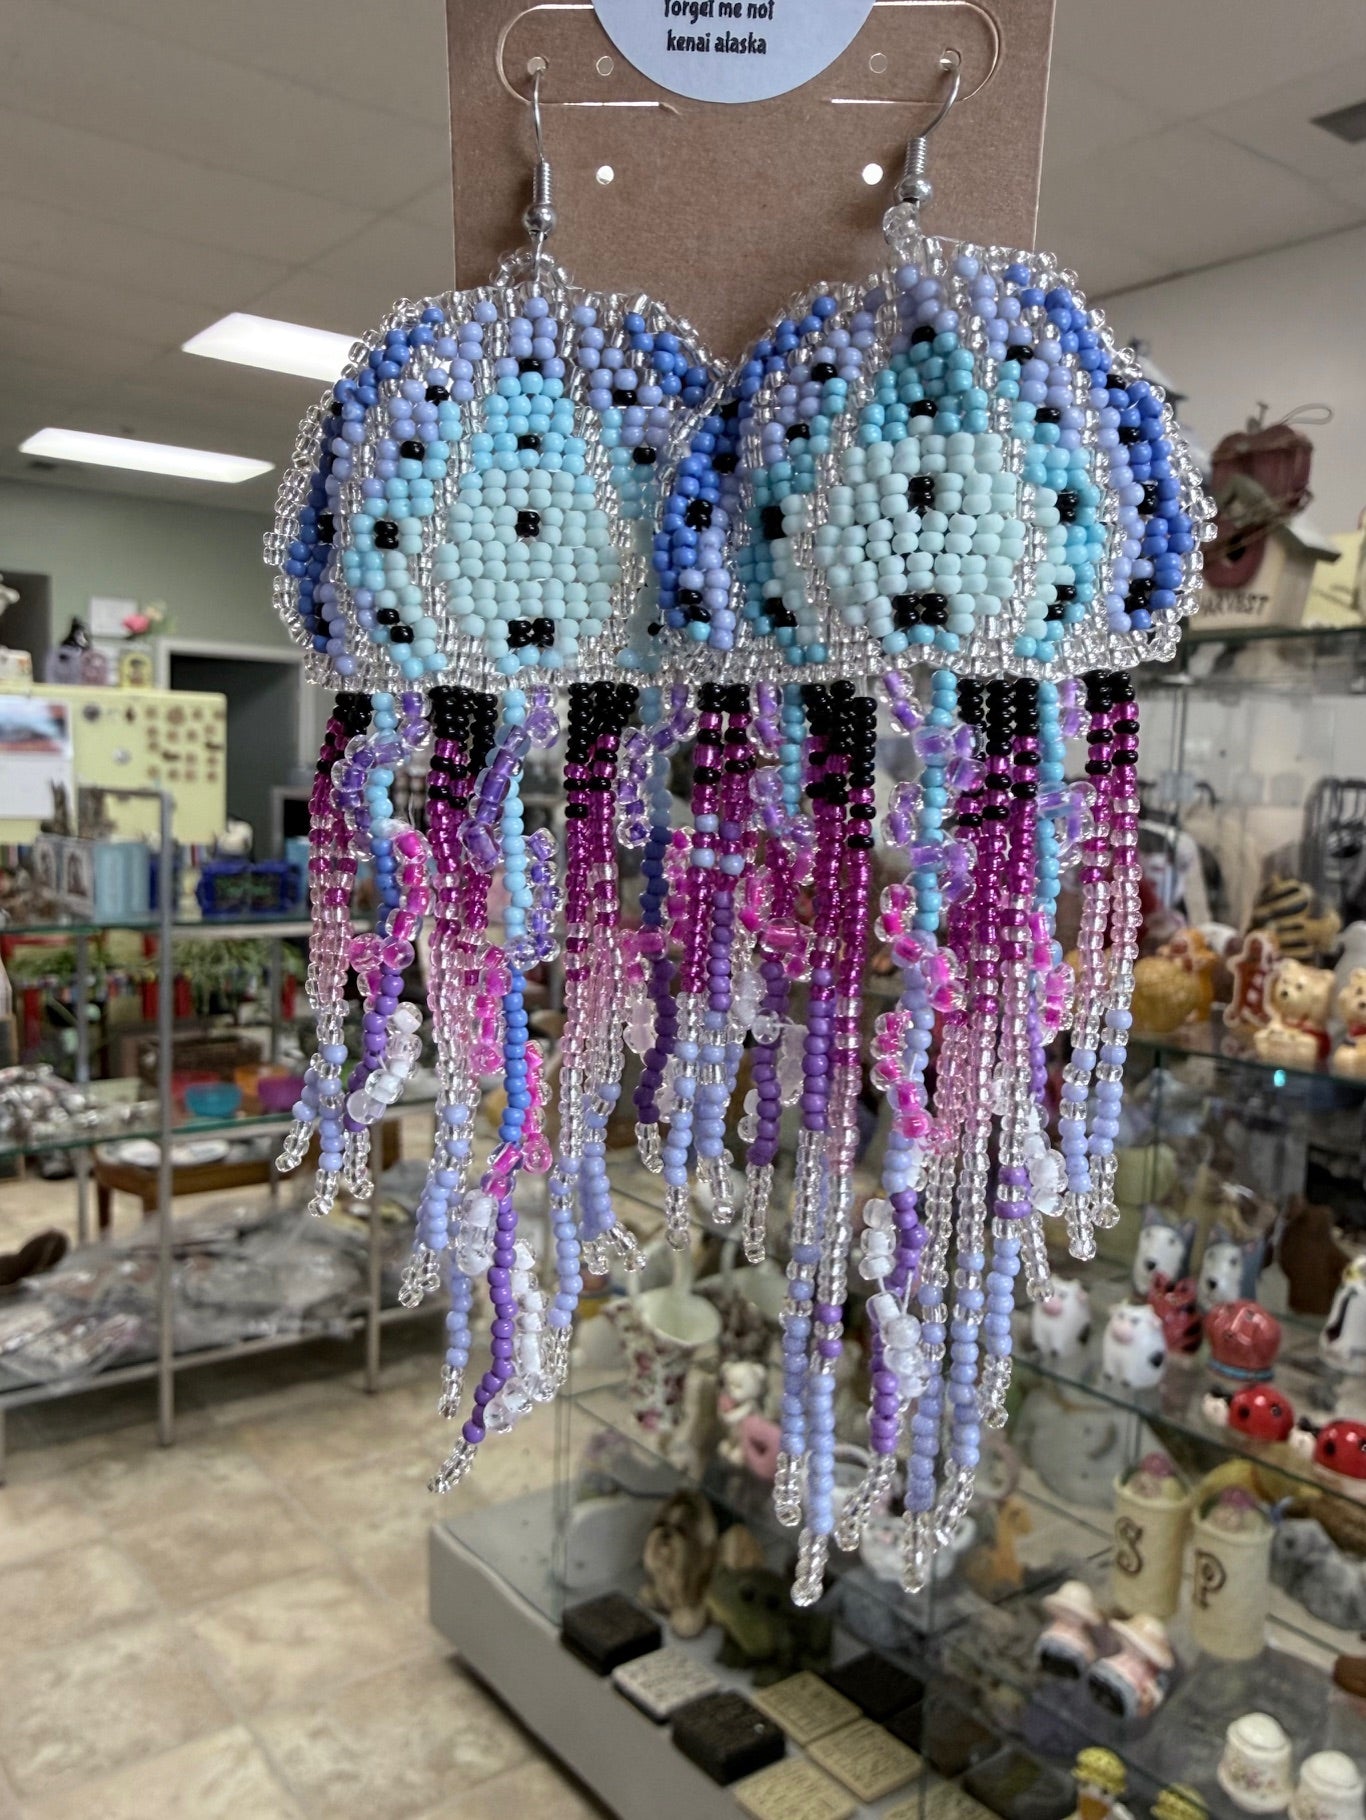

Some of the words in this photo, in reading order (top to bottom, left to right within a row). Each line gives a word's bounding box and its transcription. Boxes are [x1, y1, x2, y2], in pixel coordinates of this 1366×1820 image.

[664, 0, 714, 24] forget
[719, 1, 742, 18] me
[747, 0, 775, 20] not
[667, 29, 711, 52] kenai
[714, 31, 767, 54] alaska
